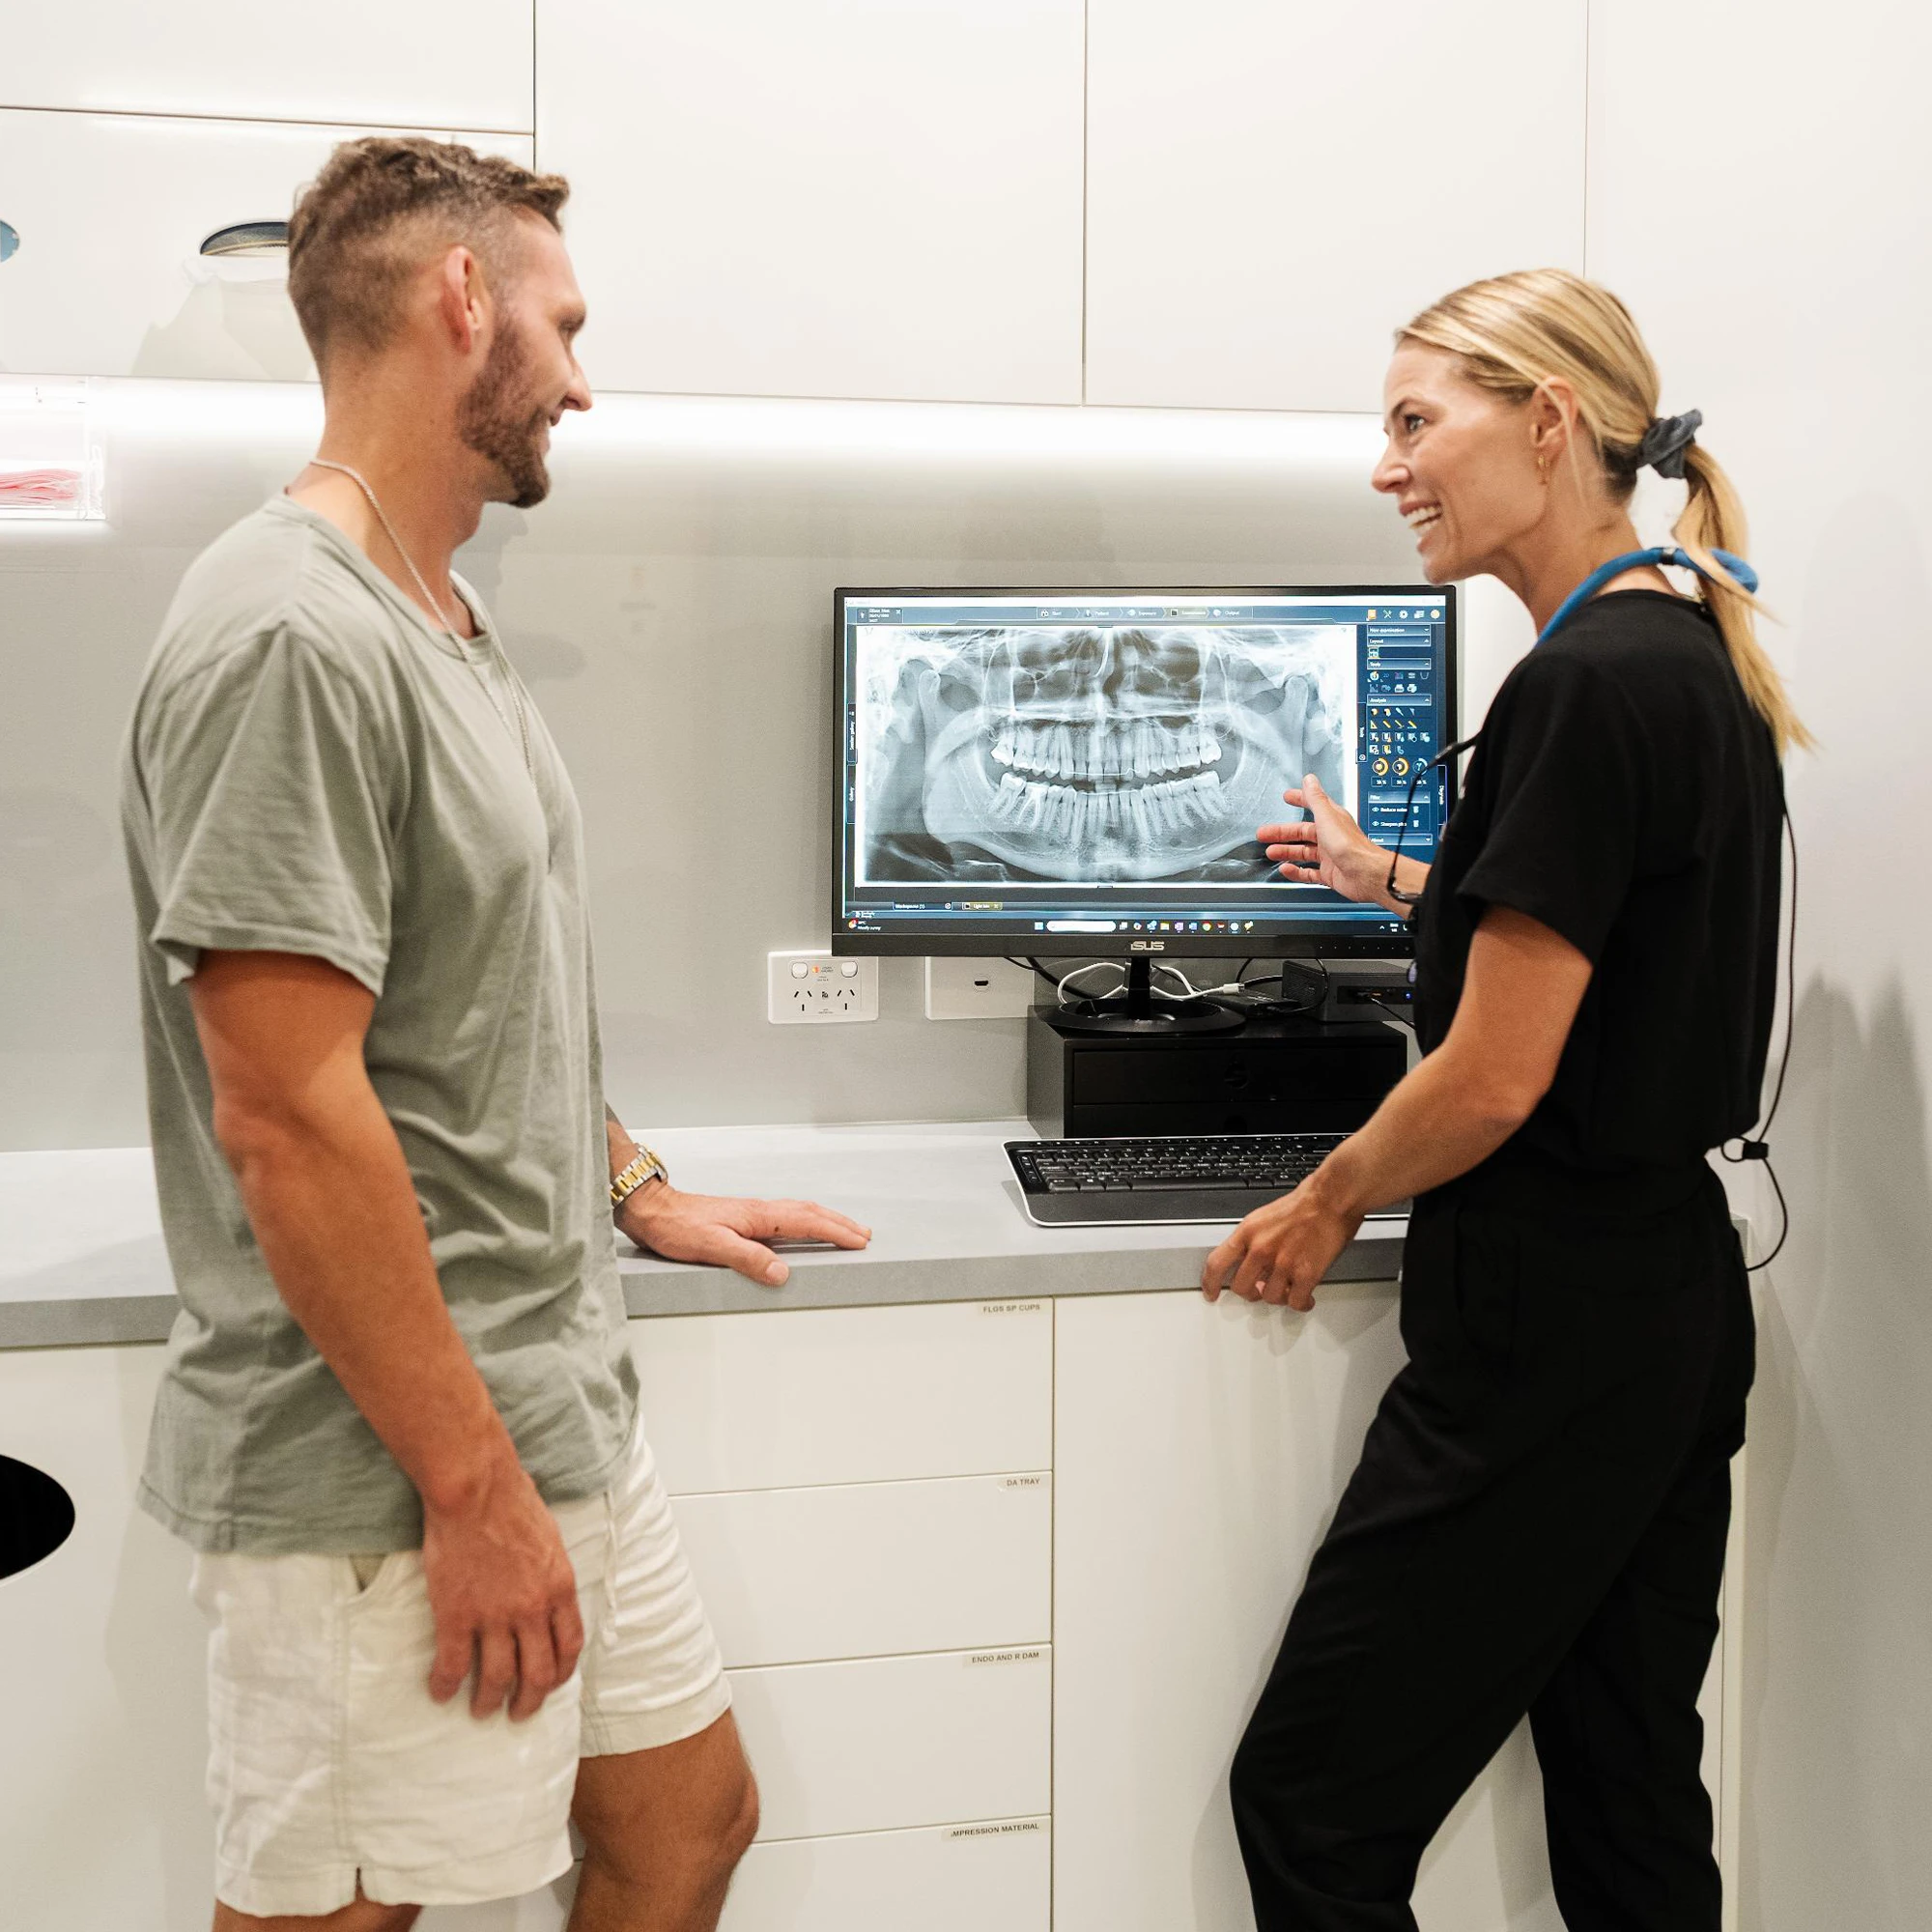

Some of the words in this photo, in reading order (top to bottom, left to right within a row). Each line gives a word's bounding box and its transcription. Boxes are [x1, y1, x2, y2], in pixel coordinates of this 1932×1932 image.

[1130, 940, 1165, 951] ASUS
[1018, 1303, 1040, 1312] CUPS
[972, 1655, 995, 1663] ENDO
[951, 1827, 999, 1837] MPRESSION
[1001, 1823, 1039, 1832] MATERIAL
